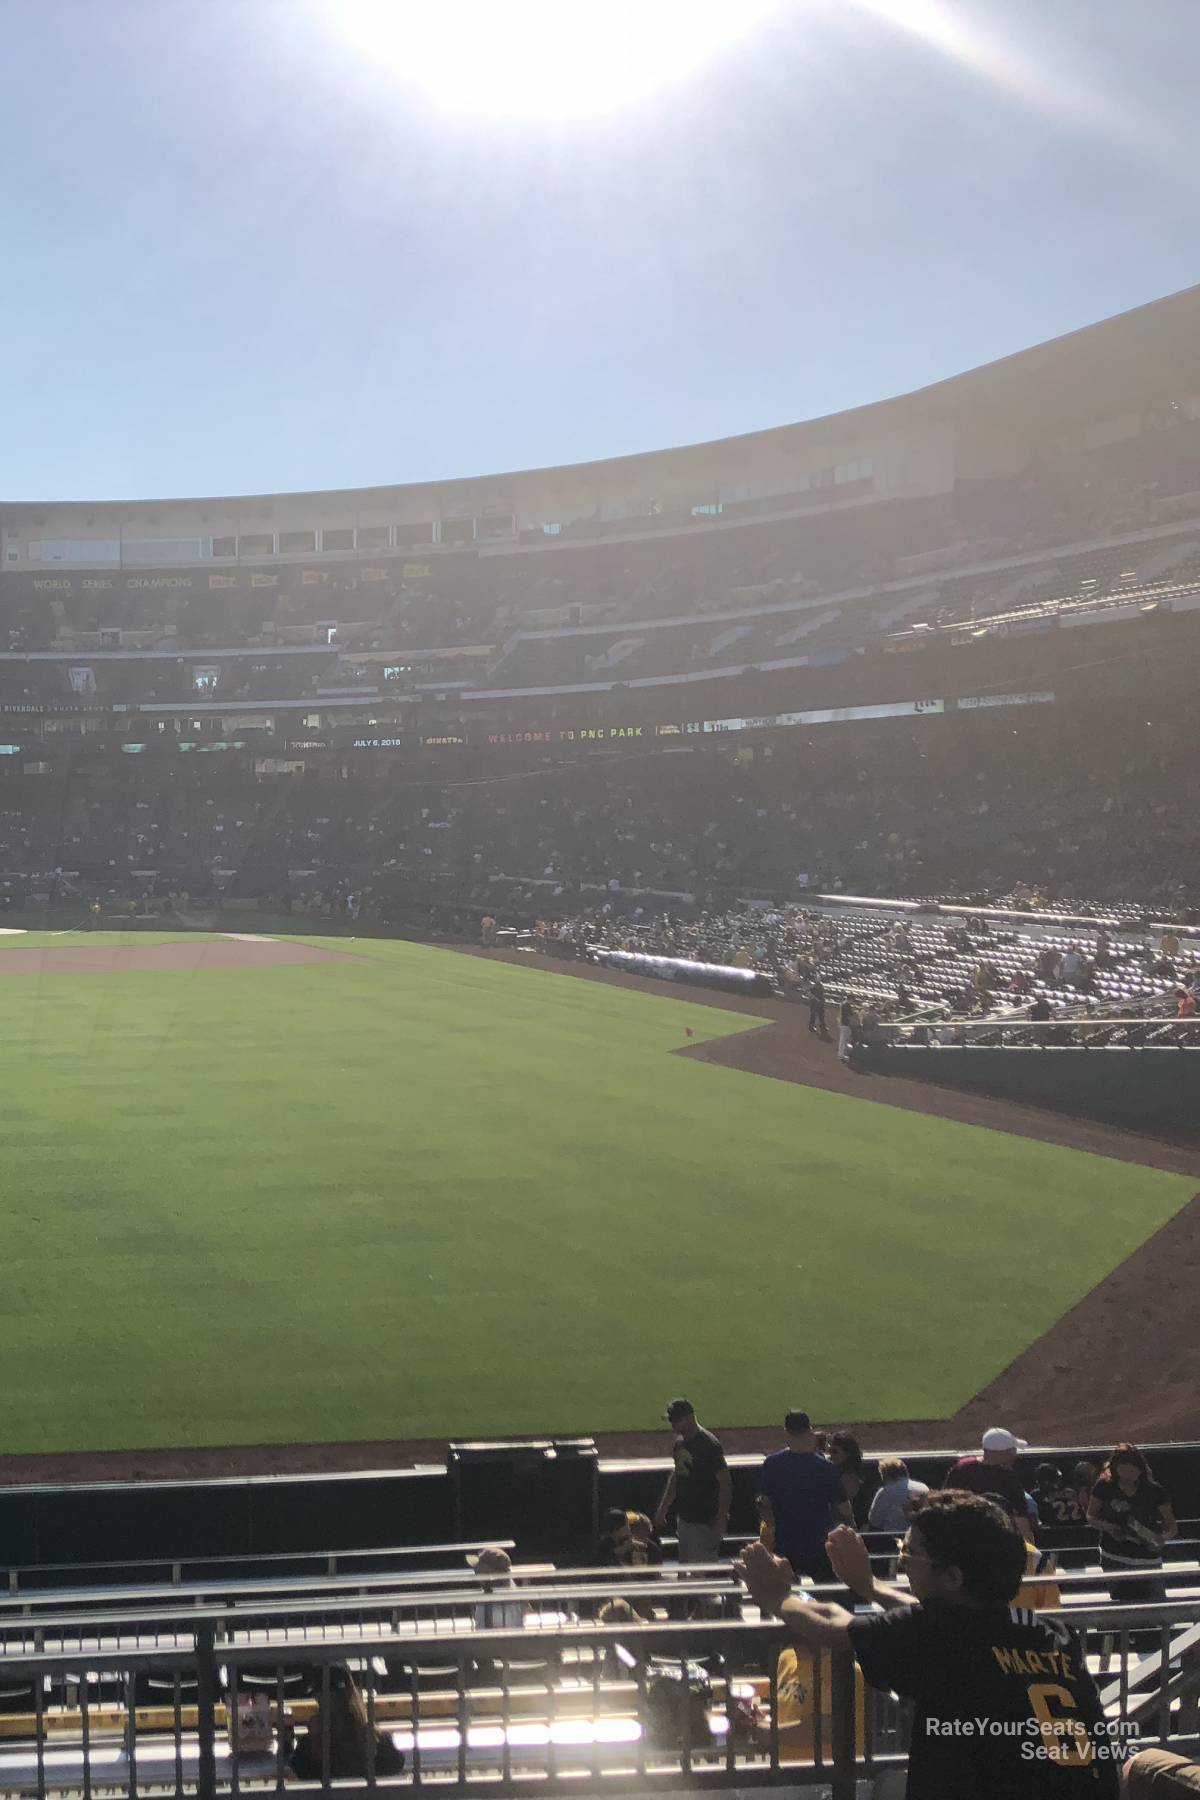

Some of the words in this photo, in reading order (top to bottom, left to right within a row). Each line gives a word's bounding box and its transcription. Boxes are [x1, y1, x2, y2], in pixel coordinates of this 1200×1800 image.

[33, 578, 71, 589] WORLD
[80, 578, 113, 589] SERIES
[127, 577, 193, 588] CHAMPIONS
[353, 739, 371, 747] JULY
[381, 738, 401, 746] 2018
[488, 732, 552, 744] WELCOME
[559, 730, 575, 741] TO
[580, 728, 604, 739] PNC
[610, 727, 642, 737] PARK
[991, 1646, 1078, 1681] MARTE
[1027, 1683, 1094, 1767] 6
